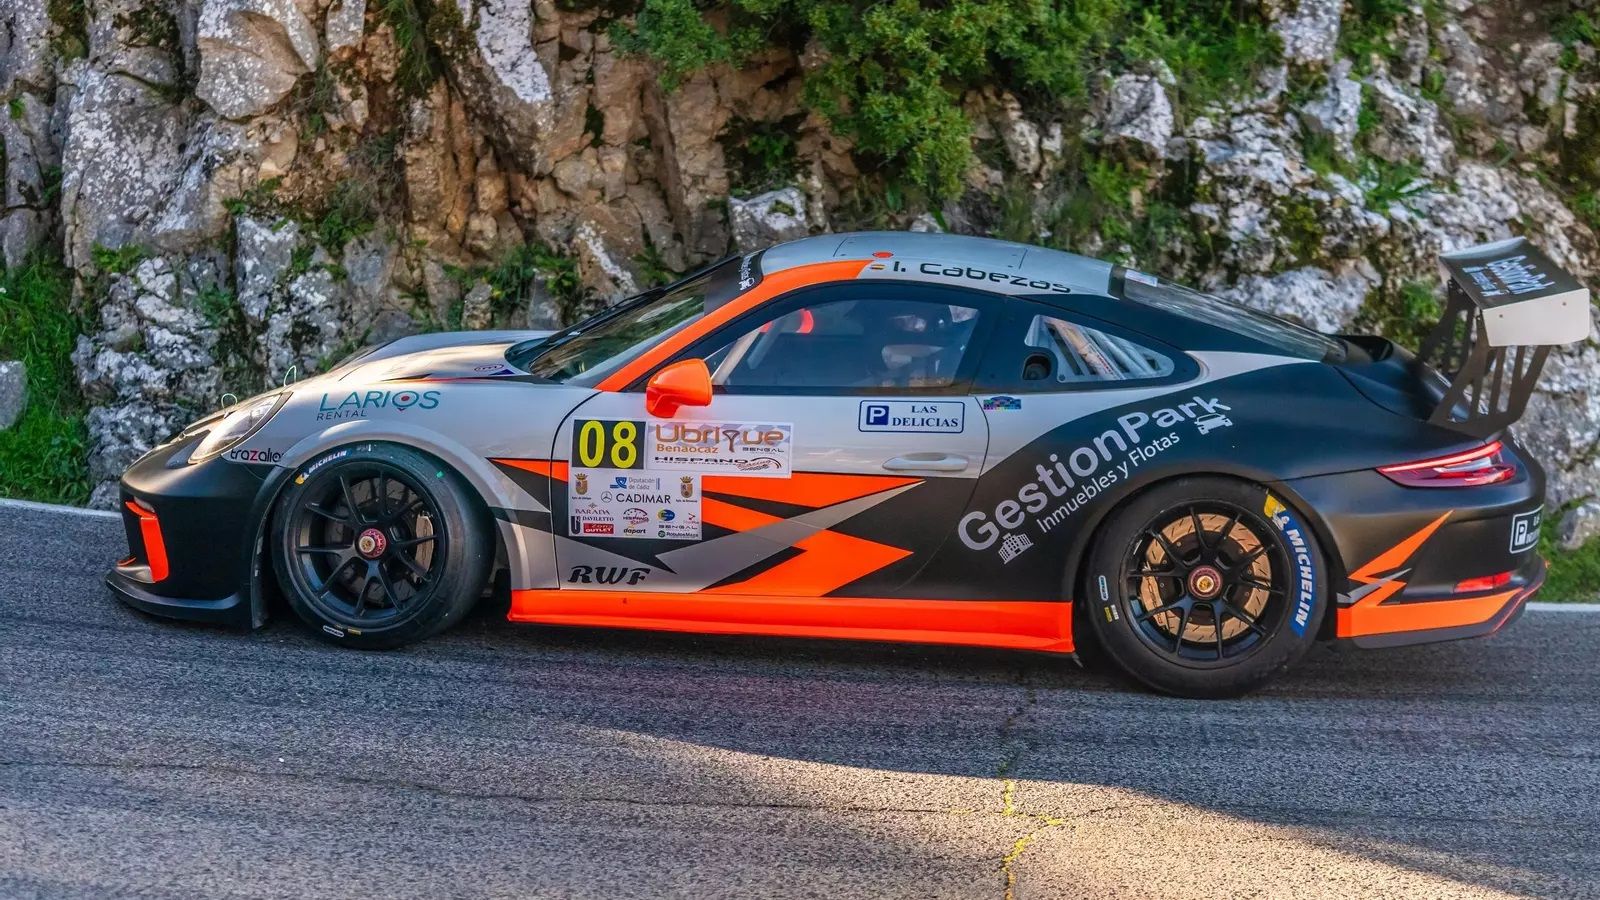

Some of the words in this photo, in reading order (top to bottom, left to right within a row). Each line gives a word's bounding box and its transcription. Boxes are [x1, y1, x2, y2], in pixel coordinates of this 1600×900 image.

[893, 261, 906, 272] I.
[919, 262, 1071, 294] Cabezas
[319, 390, 441, 411] LARIOS
[316, 409, 368, 421] RENTAL
[869, 407, 886, 424] P
[911, 405, 938, 414] LAS
[892, 417, 959, 428] DELICIAS
[579, 420, 637, 469] 08
[656, 443, 719, 454] Benaocaz
[308, 450, 348, 474] MICHELIN
[654, 456, 749, 464] HISPANO
[958, 396, 1231, 551] GestionPark
[1036, 470, 1118, 534] Inmuebles
[1117, 460, 1129, 479] y
[1128, 431, 1181, 467] Flotas
[616, 493, 671, 504] CADIMAR
[568, 565, 651, 585] RWF
[1287, 529, 1313, 627] MICHELIN
